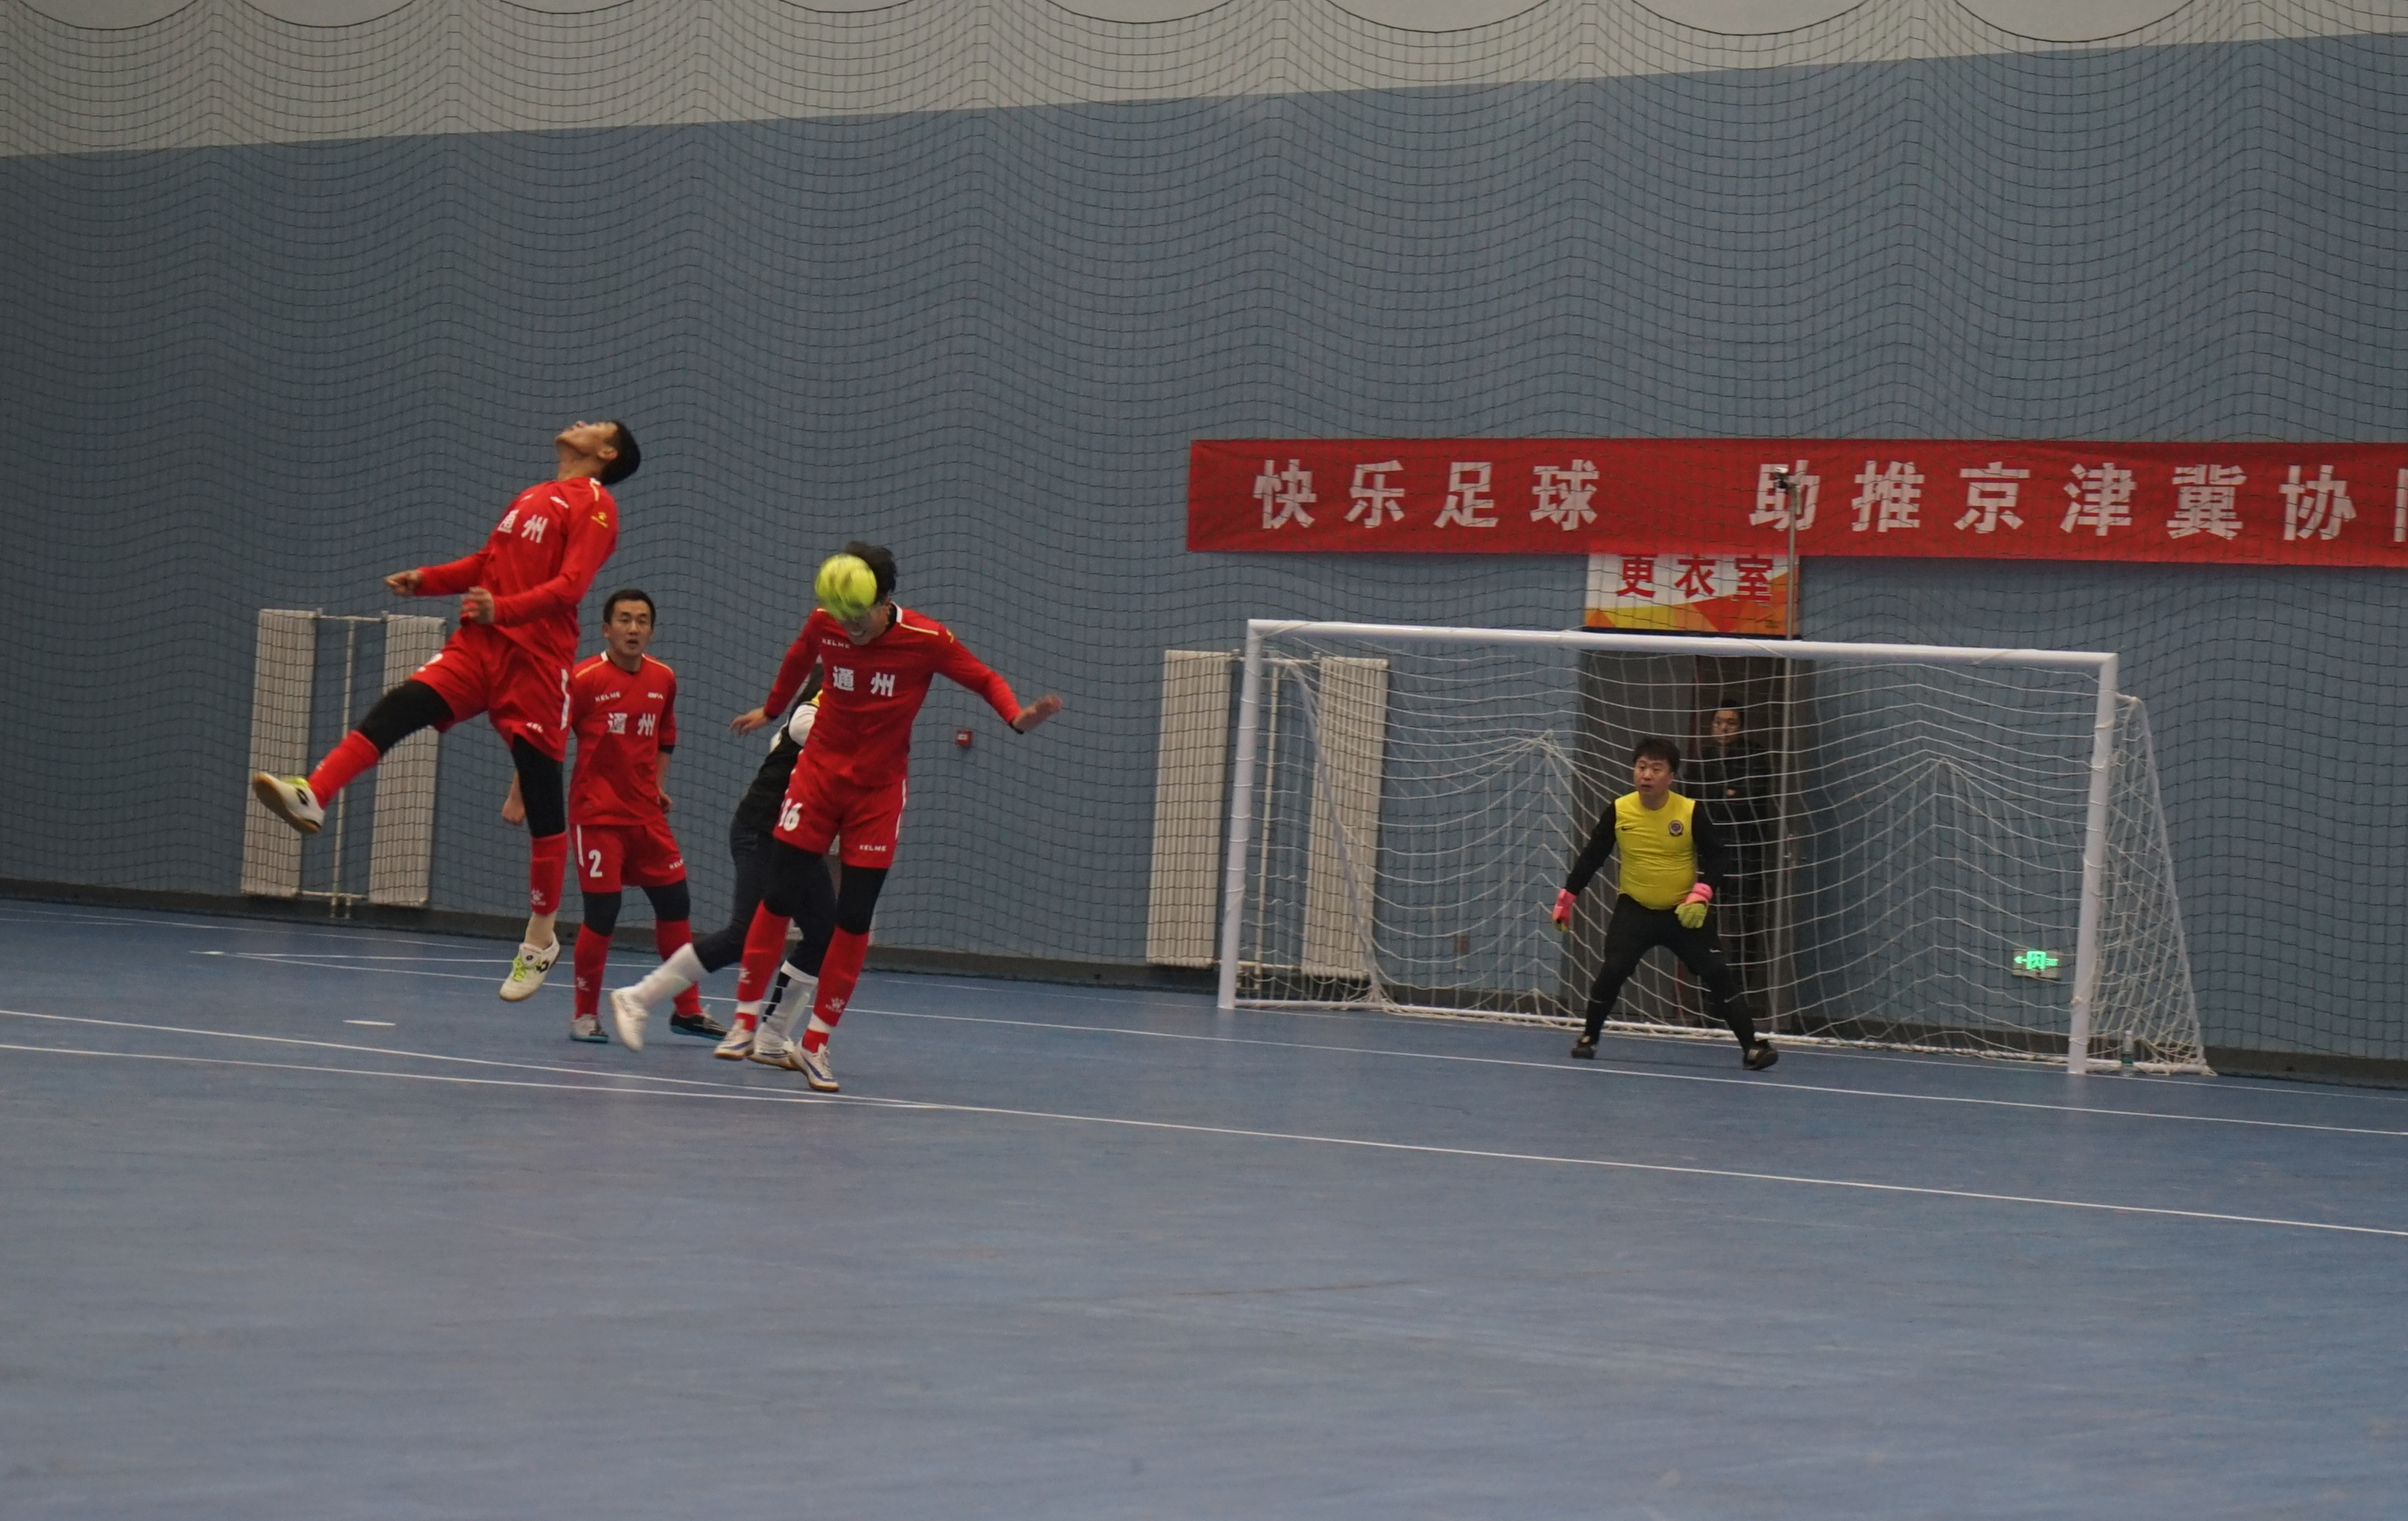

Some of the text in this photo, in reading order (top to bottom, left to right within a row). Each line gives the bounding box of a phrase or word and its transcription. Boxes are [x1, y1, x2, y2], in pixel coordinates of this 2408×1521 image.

[1253, 459, 2408, 542] 快乐足球 助推京津冀协
[1616, 554, 1773, 601] 更衣室
[821, 633, 850, 649] KELME
[832, 665, 895, 697] 通州
[607, 712, 656, 736] 通州
[778, 798, 803, 831] 16
[859, 844, 887, 852] KELME
[588, 849, 603, 878] 2
